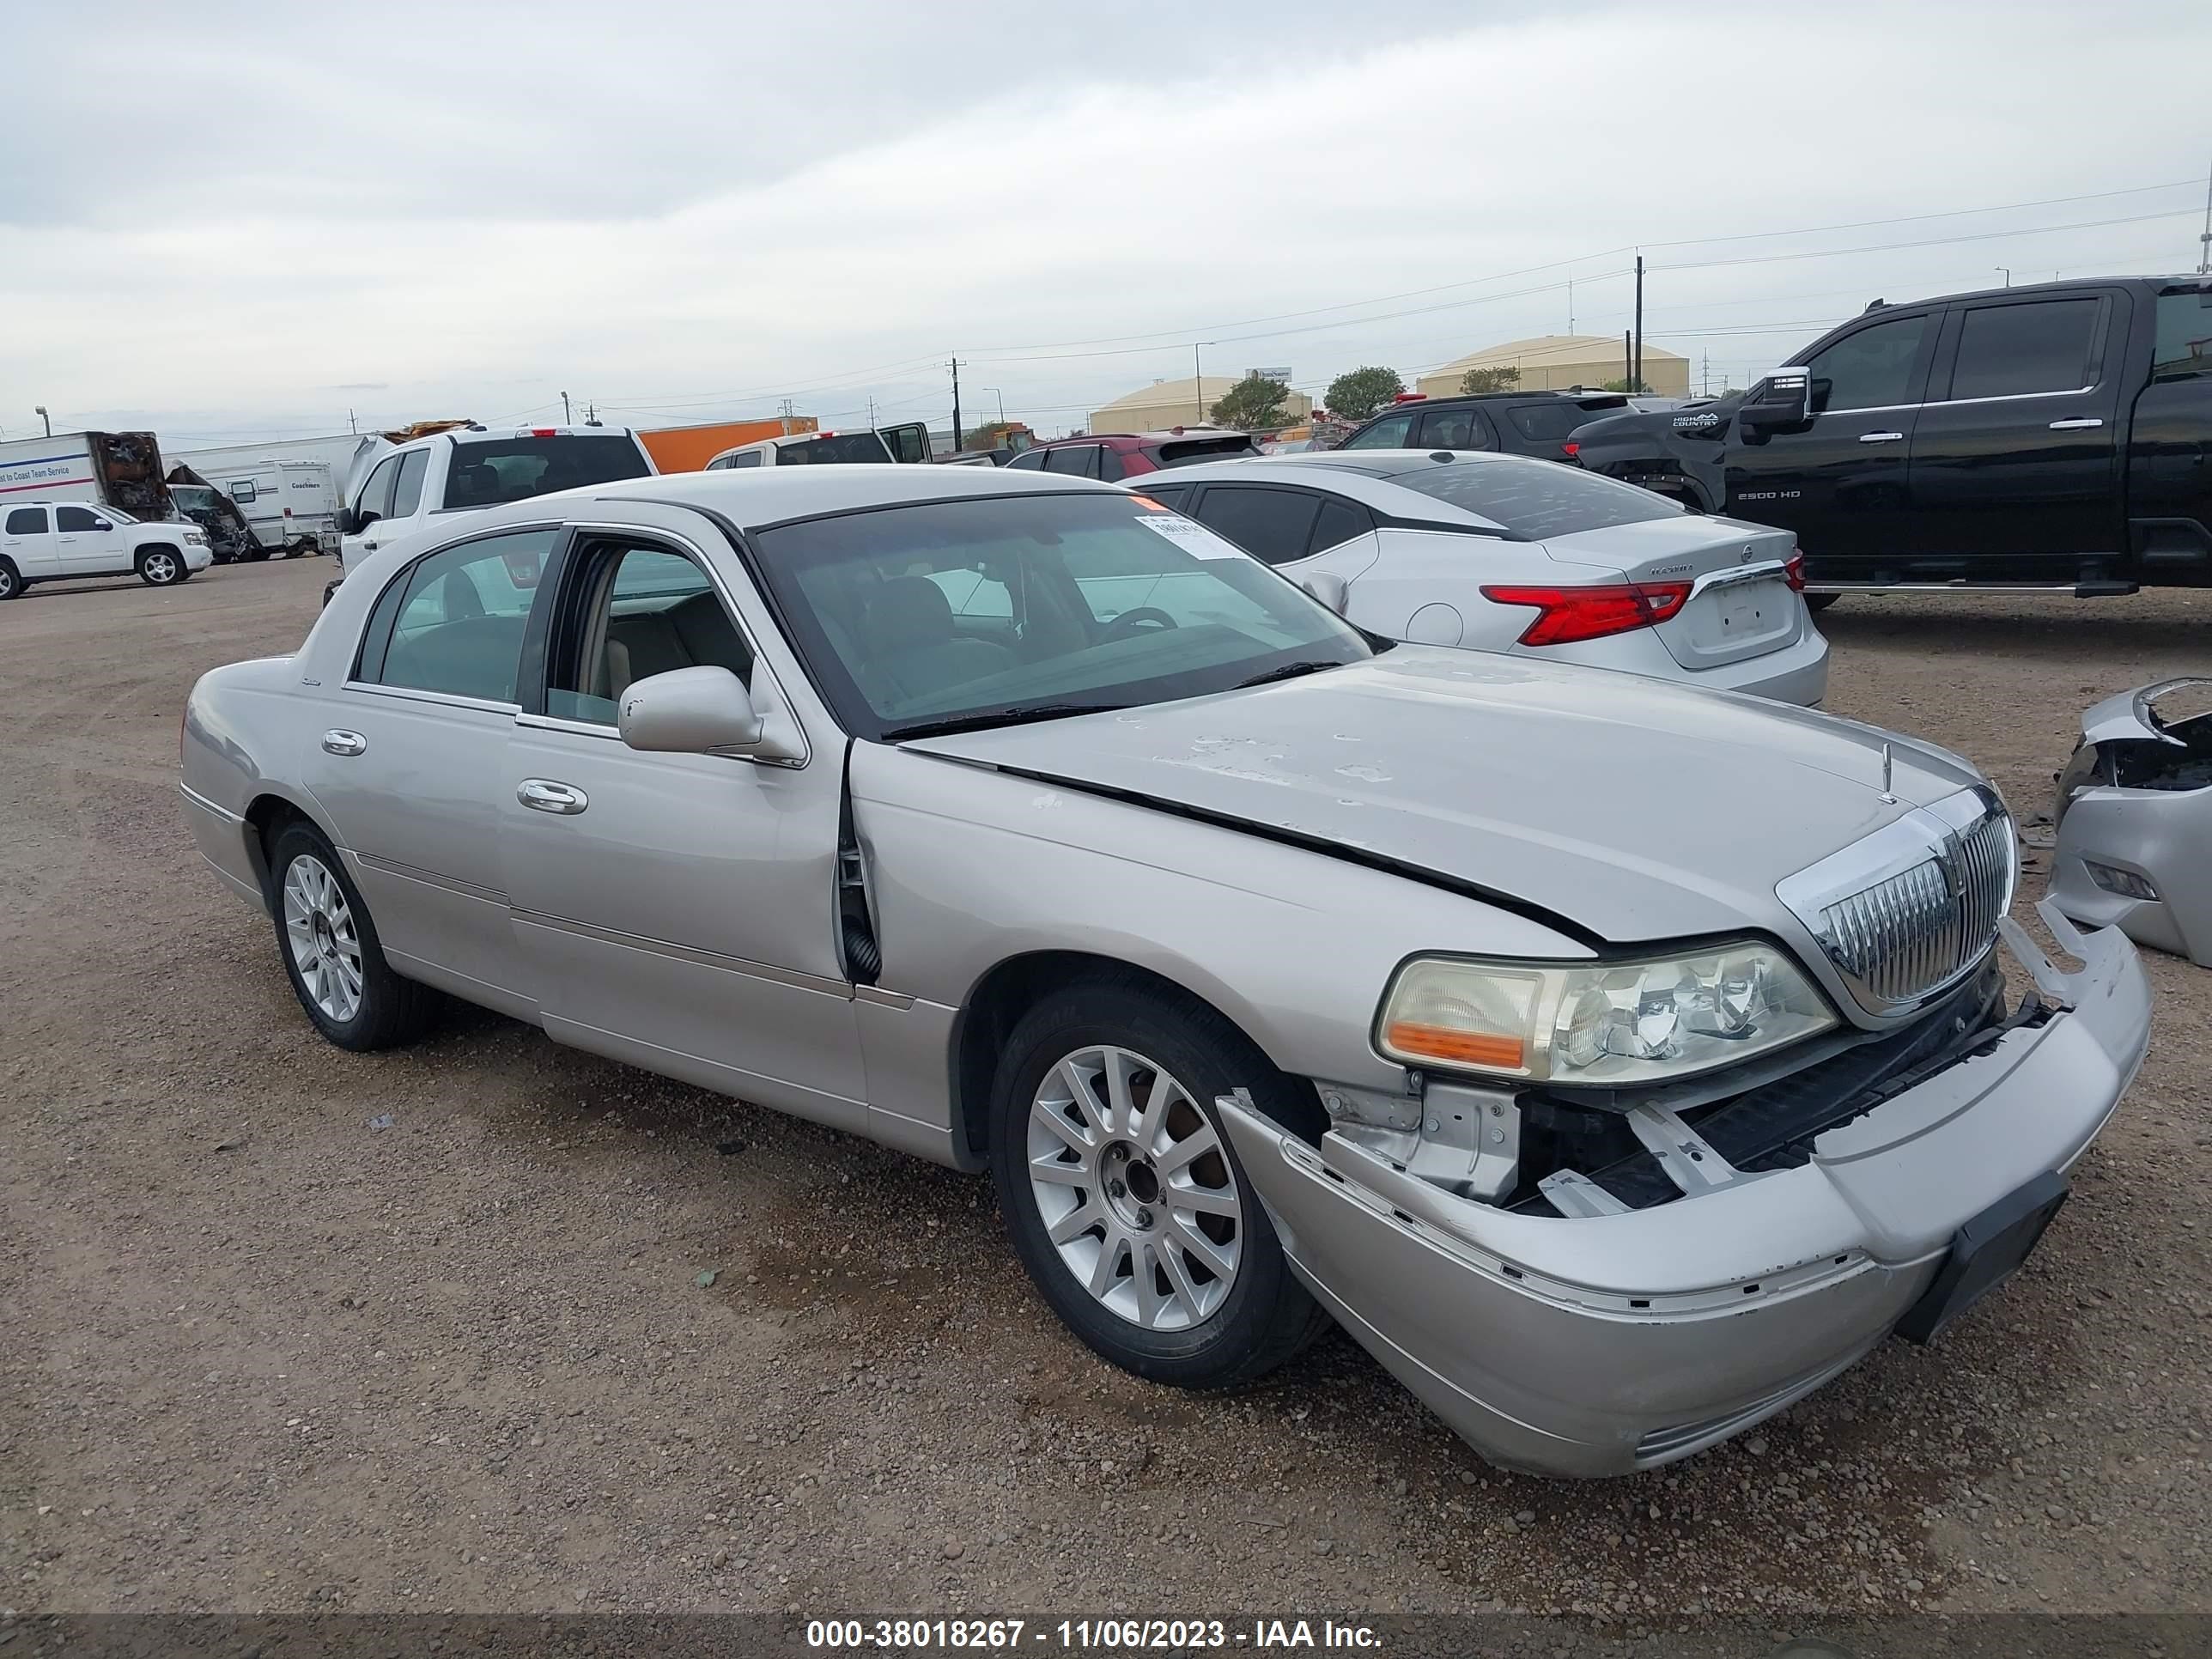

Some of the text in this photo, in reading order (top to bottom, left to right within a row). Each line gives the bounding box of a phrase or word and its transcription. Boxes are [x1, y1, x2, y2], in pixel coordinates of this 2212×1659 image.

[14, 471, 30, 480] Coast
[47, 466, 70, 476] Service
[1650, 564, 1693, 574] MAXIMA
